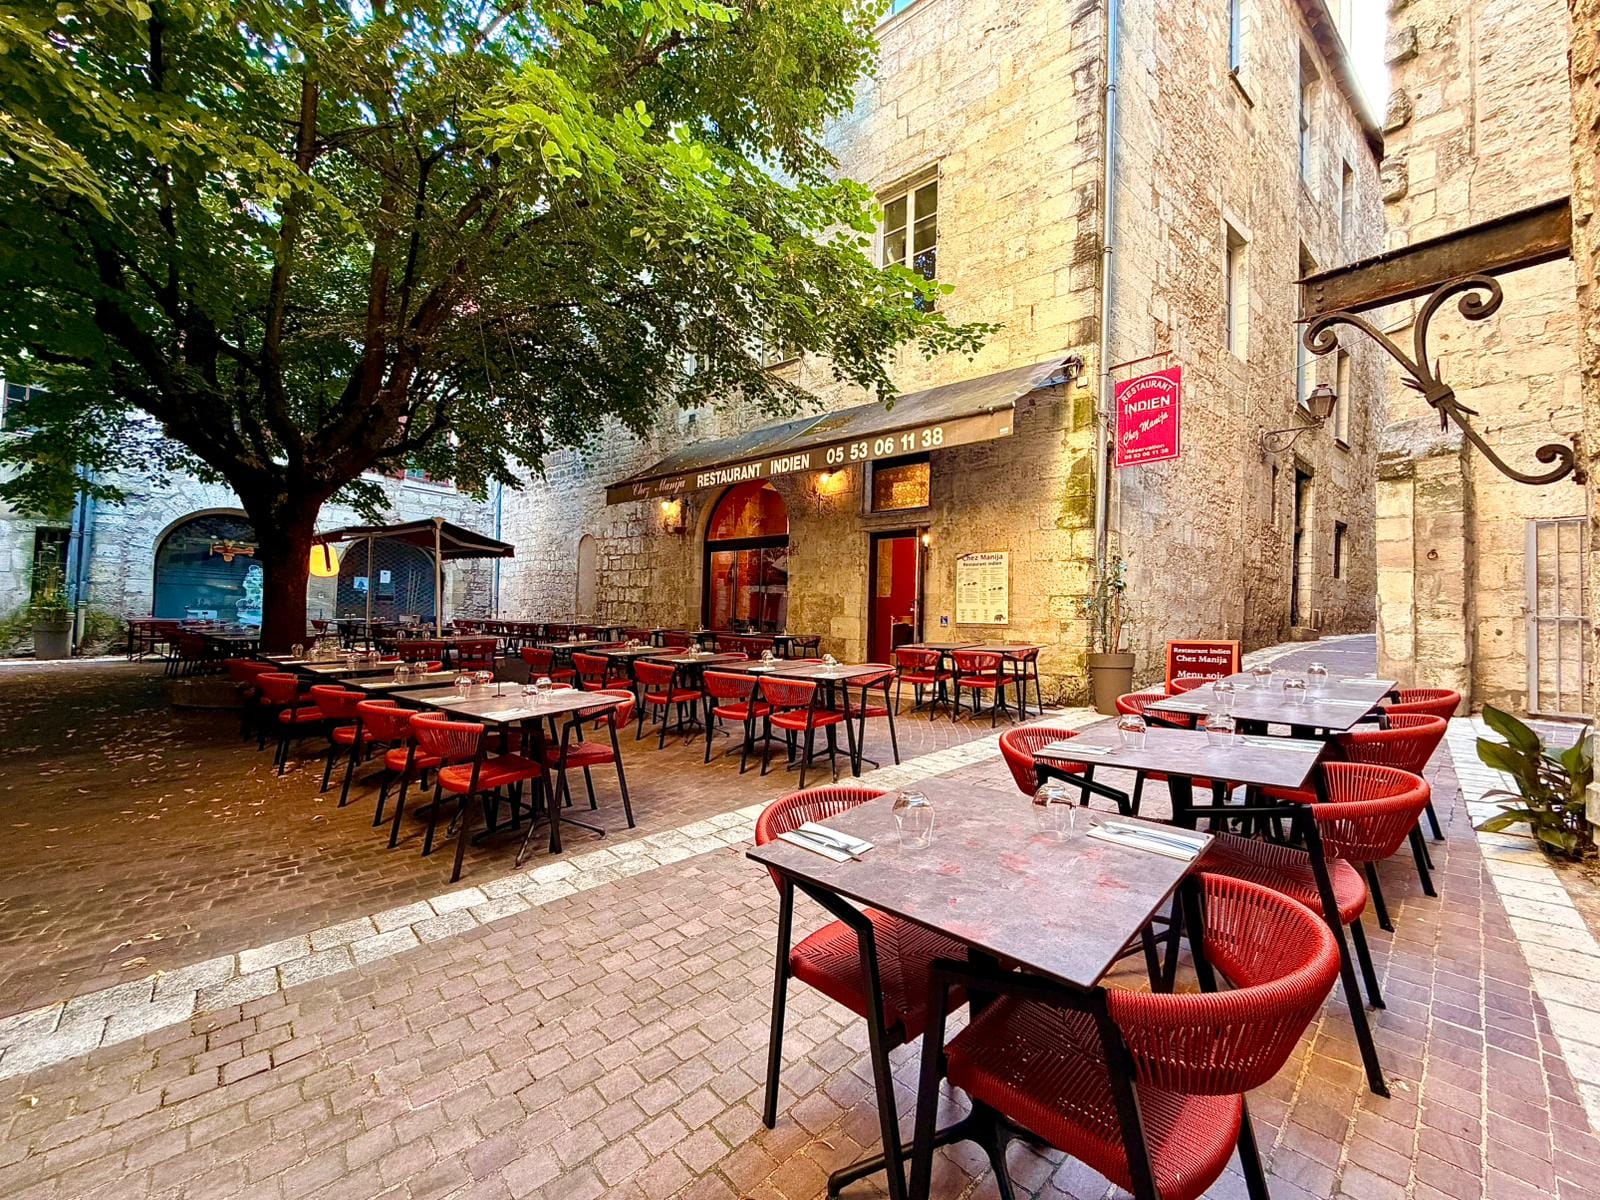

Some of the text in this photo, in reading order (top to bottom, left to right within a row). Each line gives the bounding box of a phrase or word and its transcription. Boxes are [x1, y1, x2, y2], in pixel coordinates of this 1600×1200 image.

[1121, 380, 1173, 402] RESTAURANT
[1124, 395, 1171, 415] INDIEN
[1123, 412, 1169, 446] Chez Manija
[696, 463, 762, 488] RESTAURANT
[770, 454, 809, 475] INDIEN
[826, 446, 844, 465] 05
[850, 442, 868, 460] 53
[874, 438, 894, 457] 06
[900, 433, 915, 451] 11
[921, 427, 943, 448] 38
[980, 554, 1003, 562] Manija
[1176, 654, 1227, 665] Chez Manija
[1177, 670, 1203, 678] Menu
